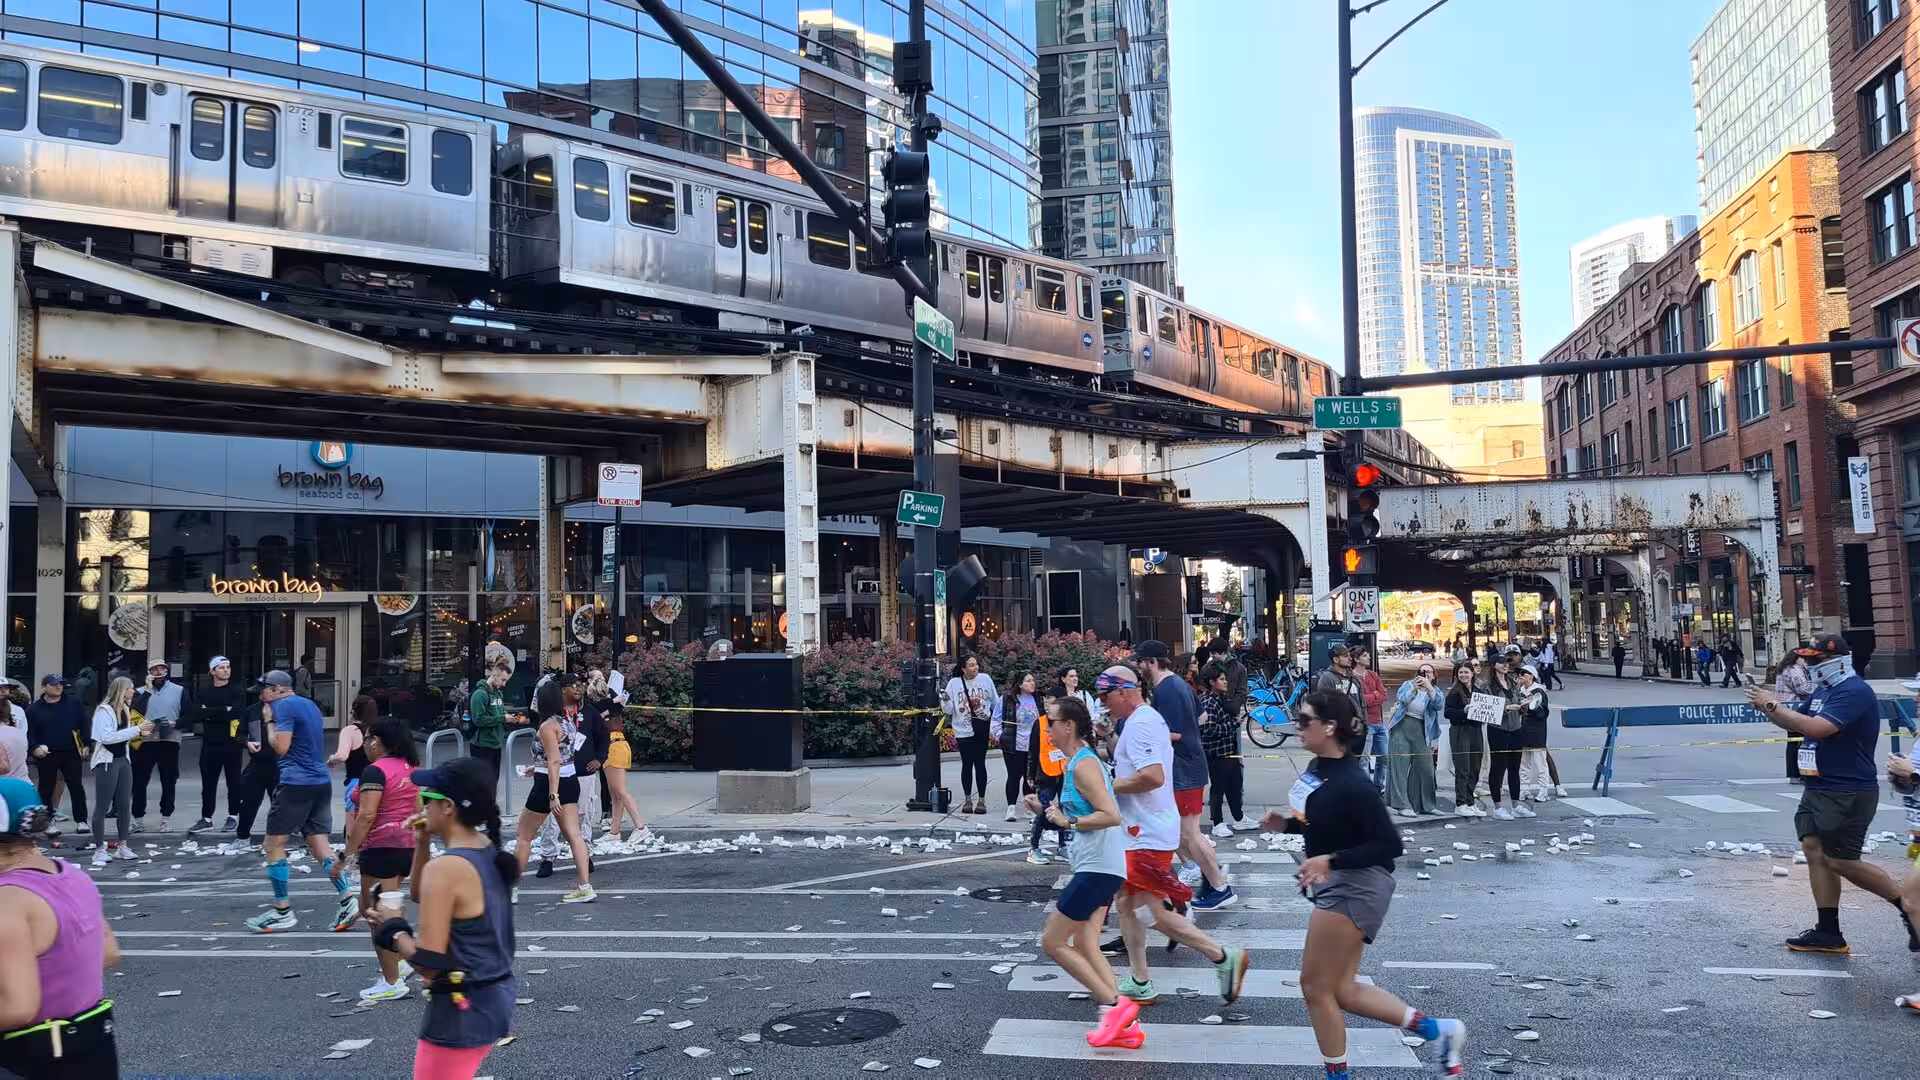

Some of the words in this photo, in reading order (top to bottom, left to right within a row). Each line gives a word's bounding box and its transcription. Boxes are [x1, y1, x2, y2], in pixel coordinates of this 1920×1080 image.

[288, 105, 314, 117] 2772
[694, 184, 711, 195] 2771
[1317, 403, 1325, 413] N
[1331, 401, 1380, 414] WELLS
[1385, 402, 1397, 412] ST
[1339, 416, 1360, 425] 200
[1370, 416, 1378, 425] W
[277, 464, 342, 488] brown
[347, 465, 384, 500] bag
[299, 489, 343, 499] seafood
[902, 493, 939, 514] PARKING
[1860, 482, 1871, 520] ARIES
[37, 568, 63, 578] 1029
[211, 573, 279, 596] brown
[282, 570, 322, 604] bag
[245, 594, 277, 602] seafood
[1679, 705, 1716, 719] POLICE
